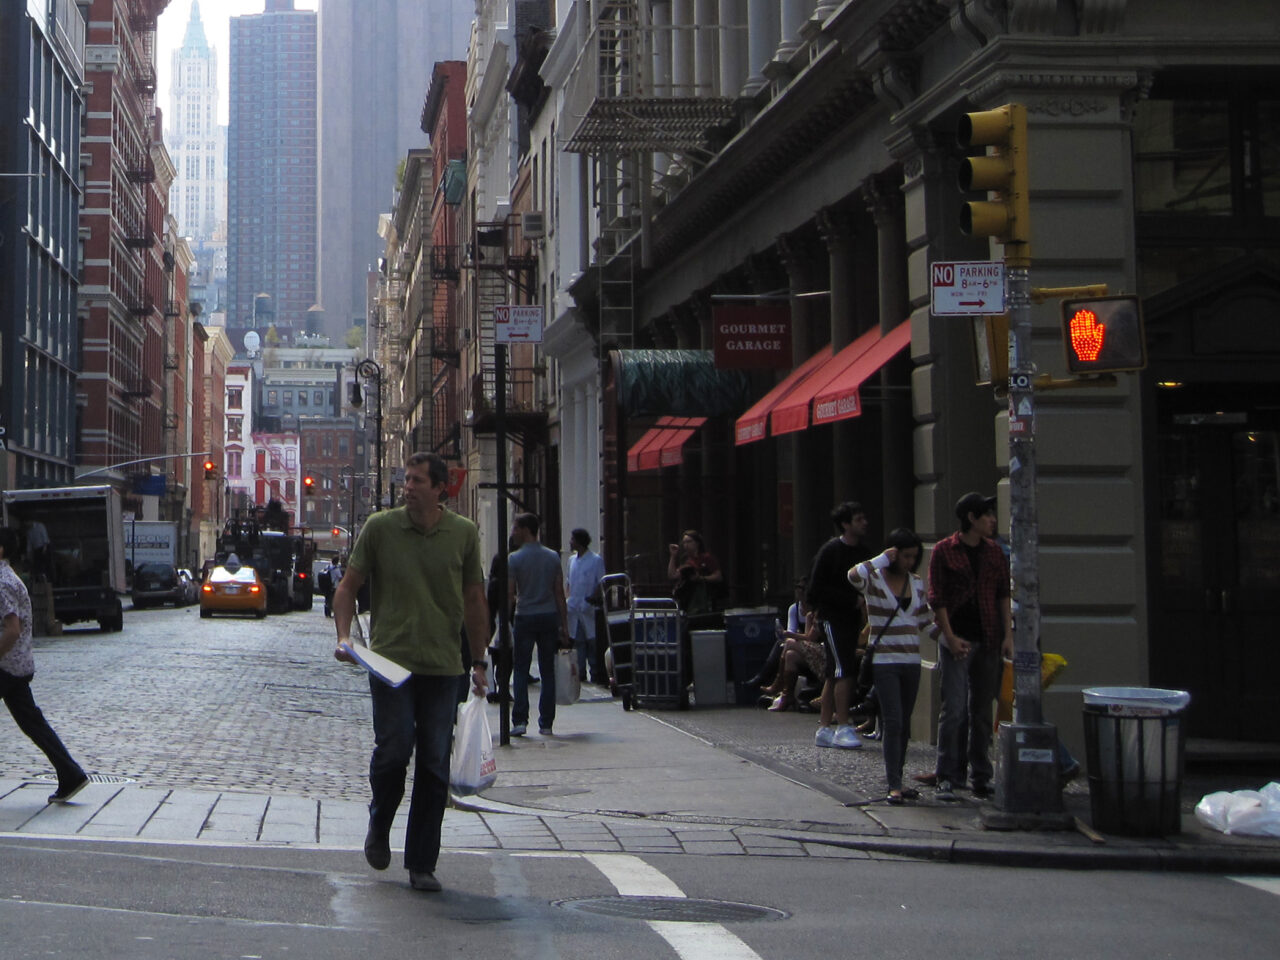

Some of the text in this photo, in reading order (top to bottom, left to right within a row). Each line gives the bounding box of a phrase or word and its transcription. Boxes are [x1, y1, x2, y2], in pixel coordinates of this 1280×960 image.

[933, 266, 1000, 284] NO PARKING
[496, 308, 540, 321] NO PARKING
[719, 324, 787, 334] GOURMET
[725, 340, 782, 351] GARAGE
